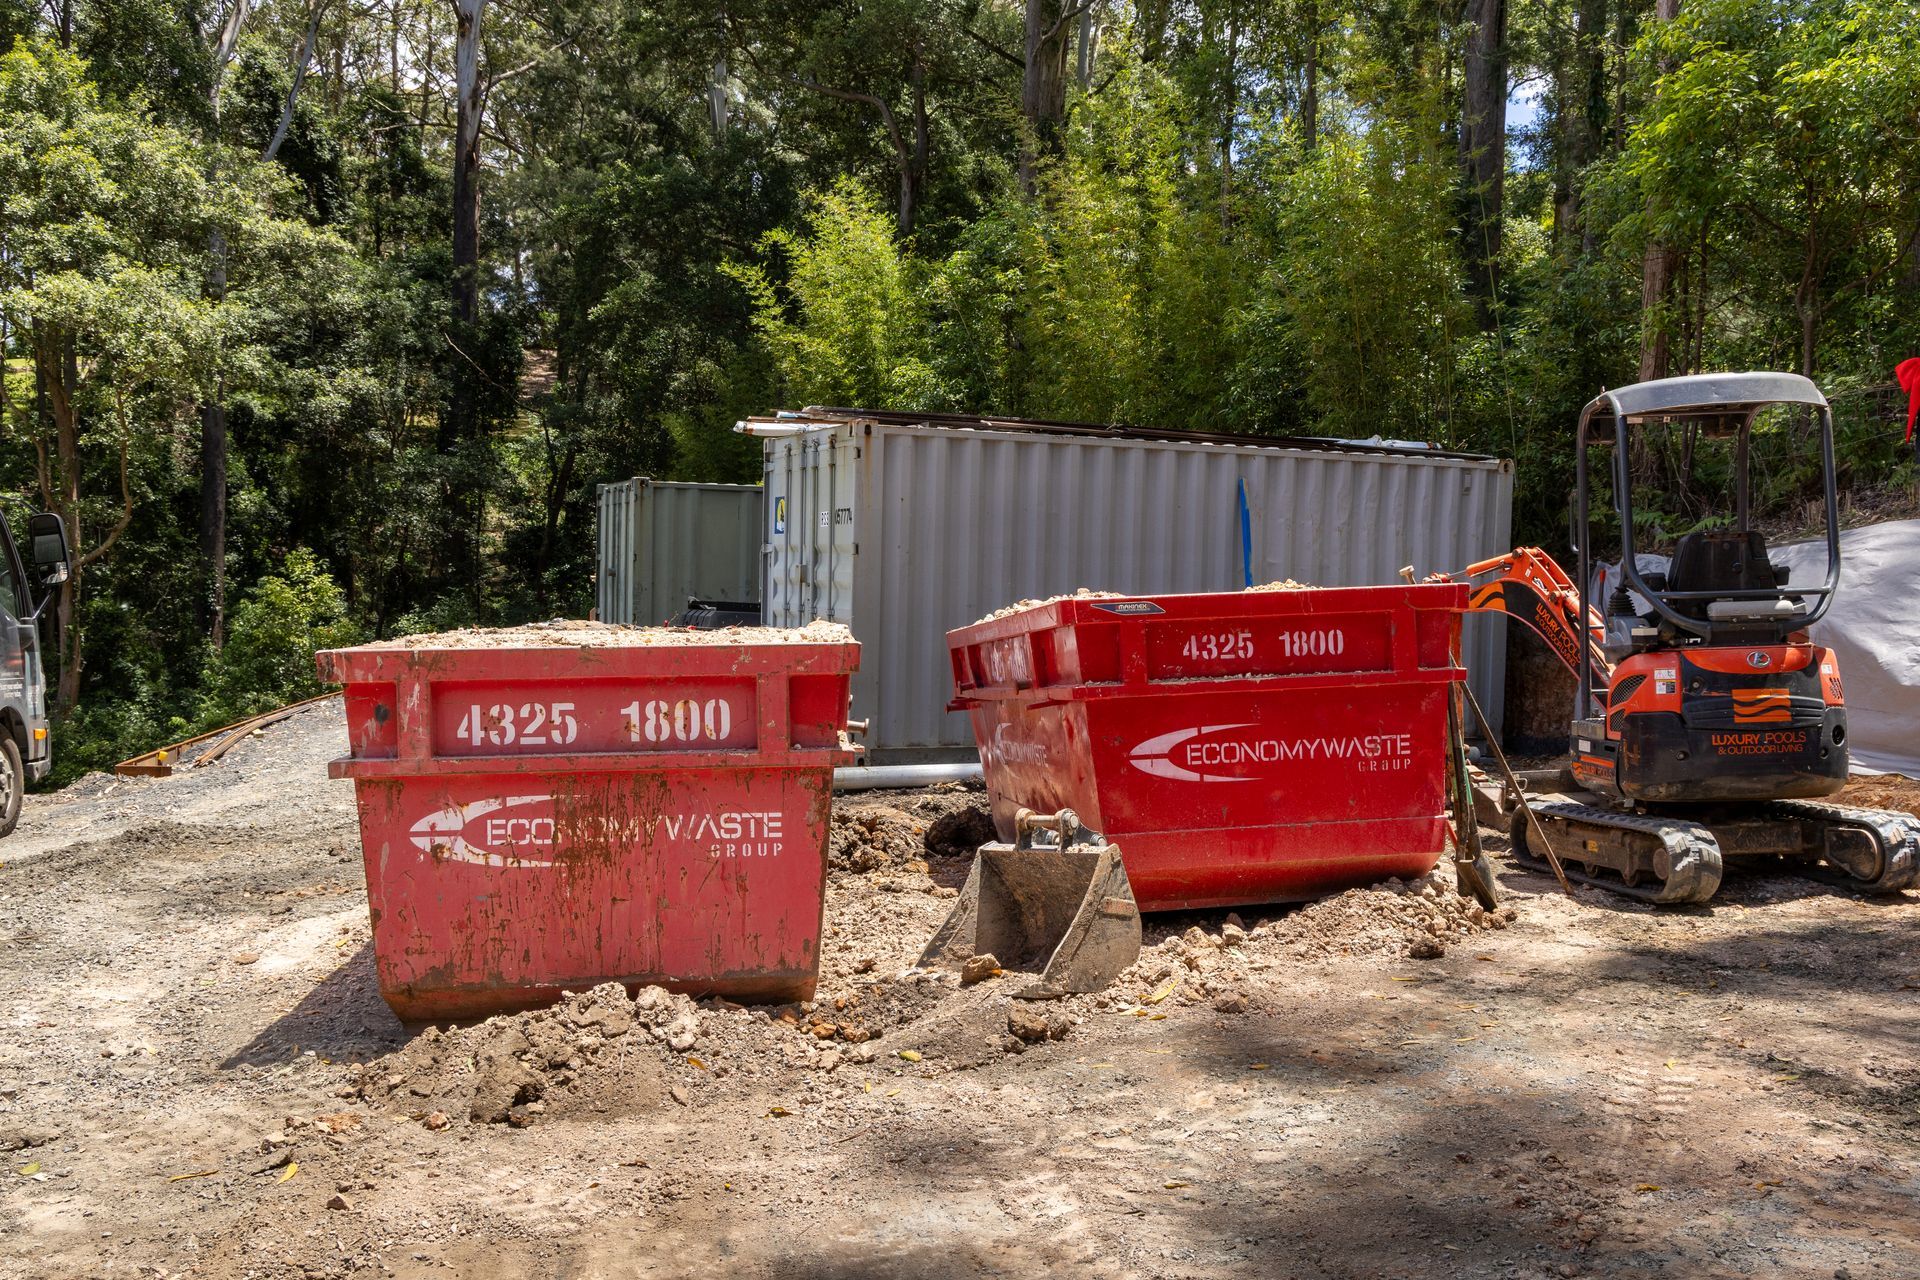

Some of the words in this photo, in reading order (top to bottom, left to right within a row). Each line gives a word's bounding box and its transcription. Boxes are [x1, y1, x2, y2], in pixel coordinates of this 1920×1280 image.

[1536, 603, 1560, 632] LUXURY
[1182, 633, 1254, 660] 4325
[1279, 629, 1344, 657] 1800
[456, 702, 578, 746] 4325
[620, 698, 730, 742] 1800
[1711, 733, 1760, 746] LUXURY
[1764, 731, 1806, 744] POOLS
[1186, 734, 1411, 766] ECONOMYWASTE
[1718, 746, 1726, 755] &
[1358, 758, 1412, 772] GROUP
[710, 843, 783, 858] GROUP
